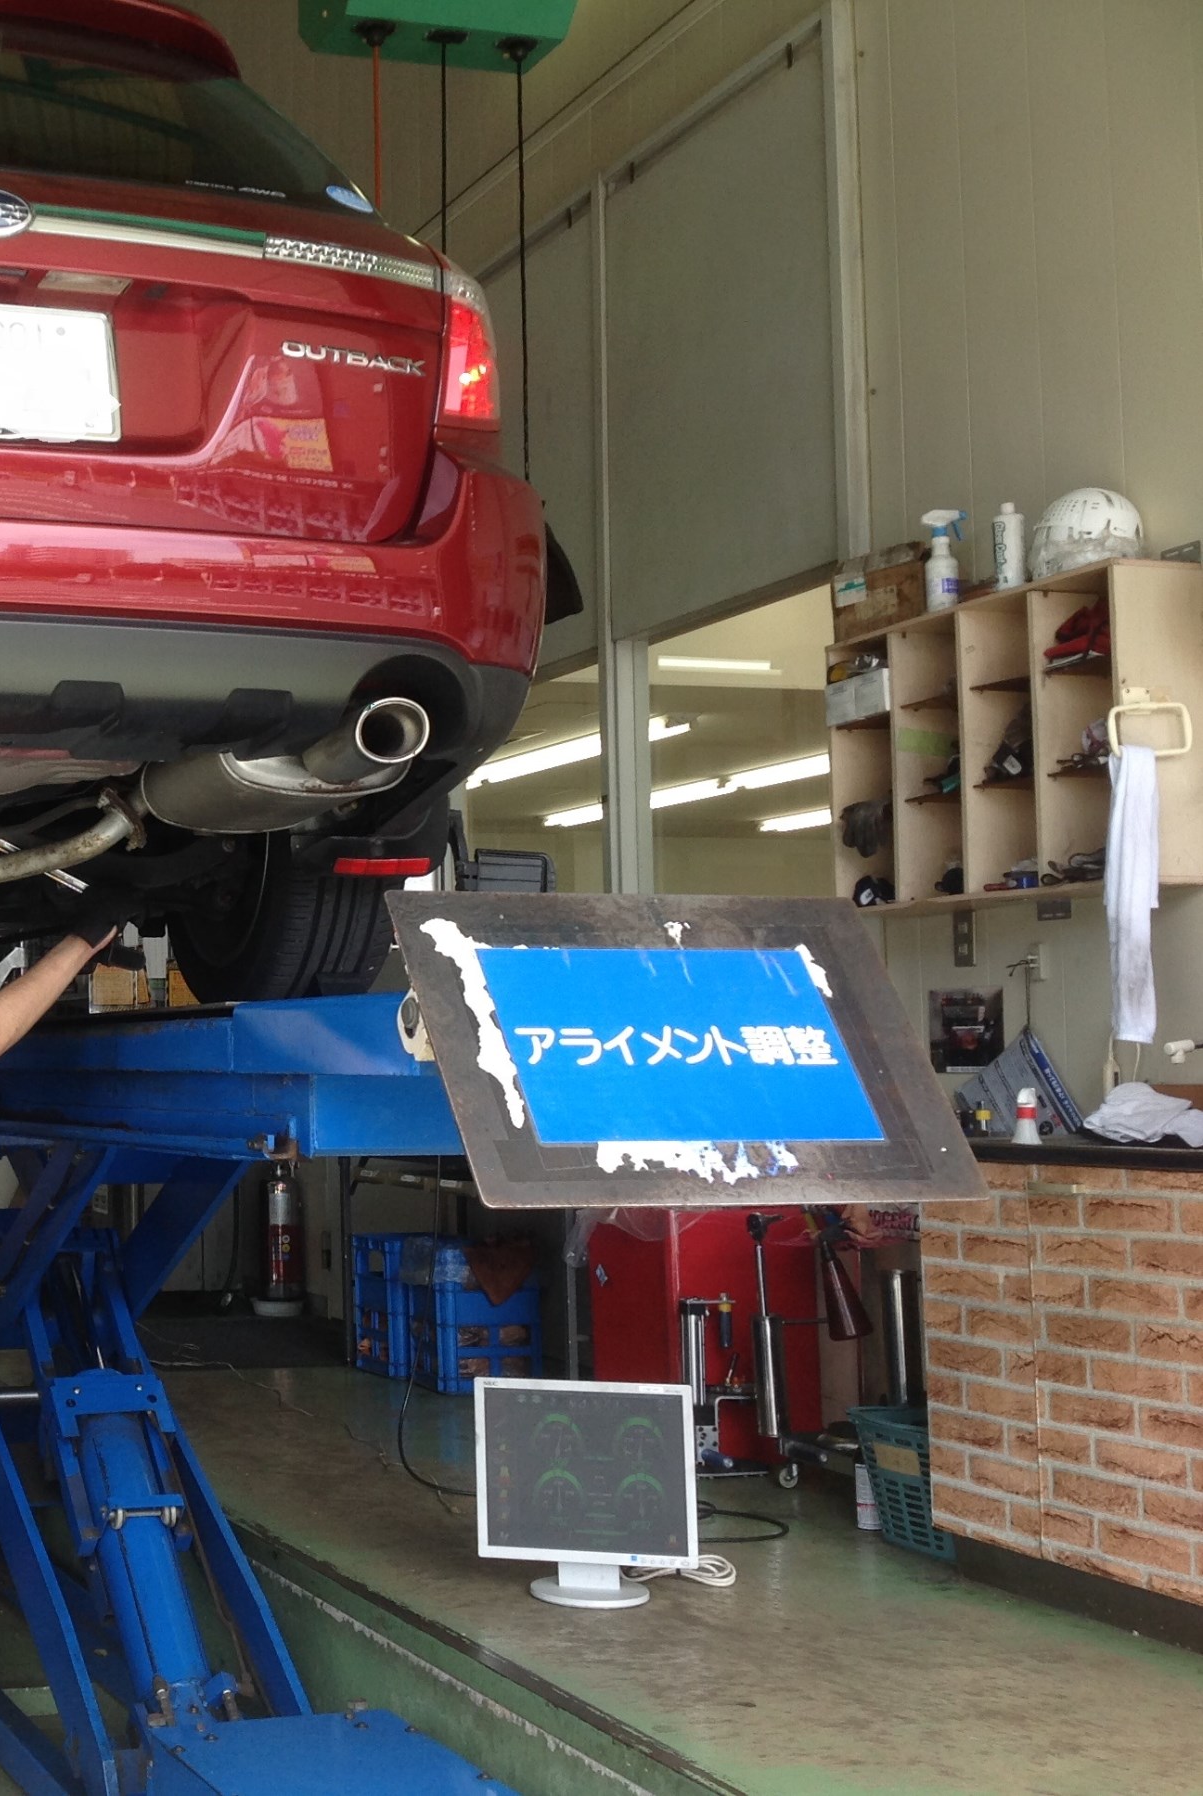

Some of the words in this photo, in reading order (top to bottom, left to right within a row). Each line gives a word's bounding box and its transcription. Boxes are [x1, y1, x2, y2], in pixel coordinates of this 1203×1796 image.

[281, 340, 427, 378] OUTBACK
[513, 1025, 839, 1066] アライメント調整
